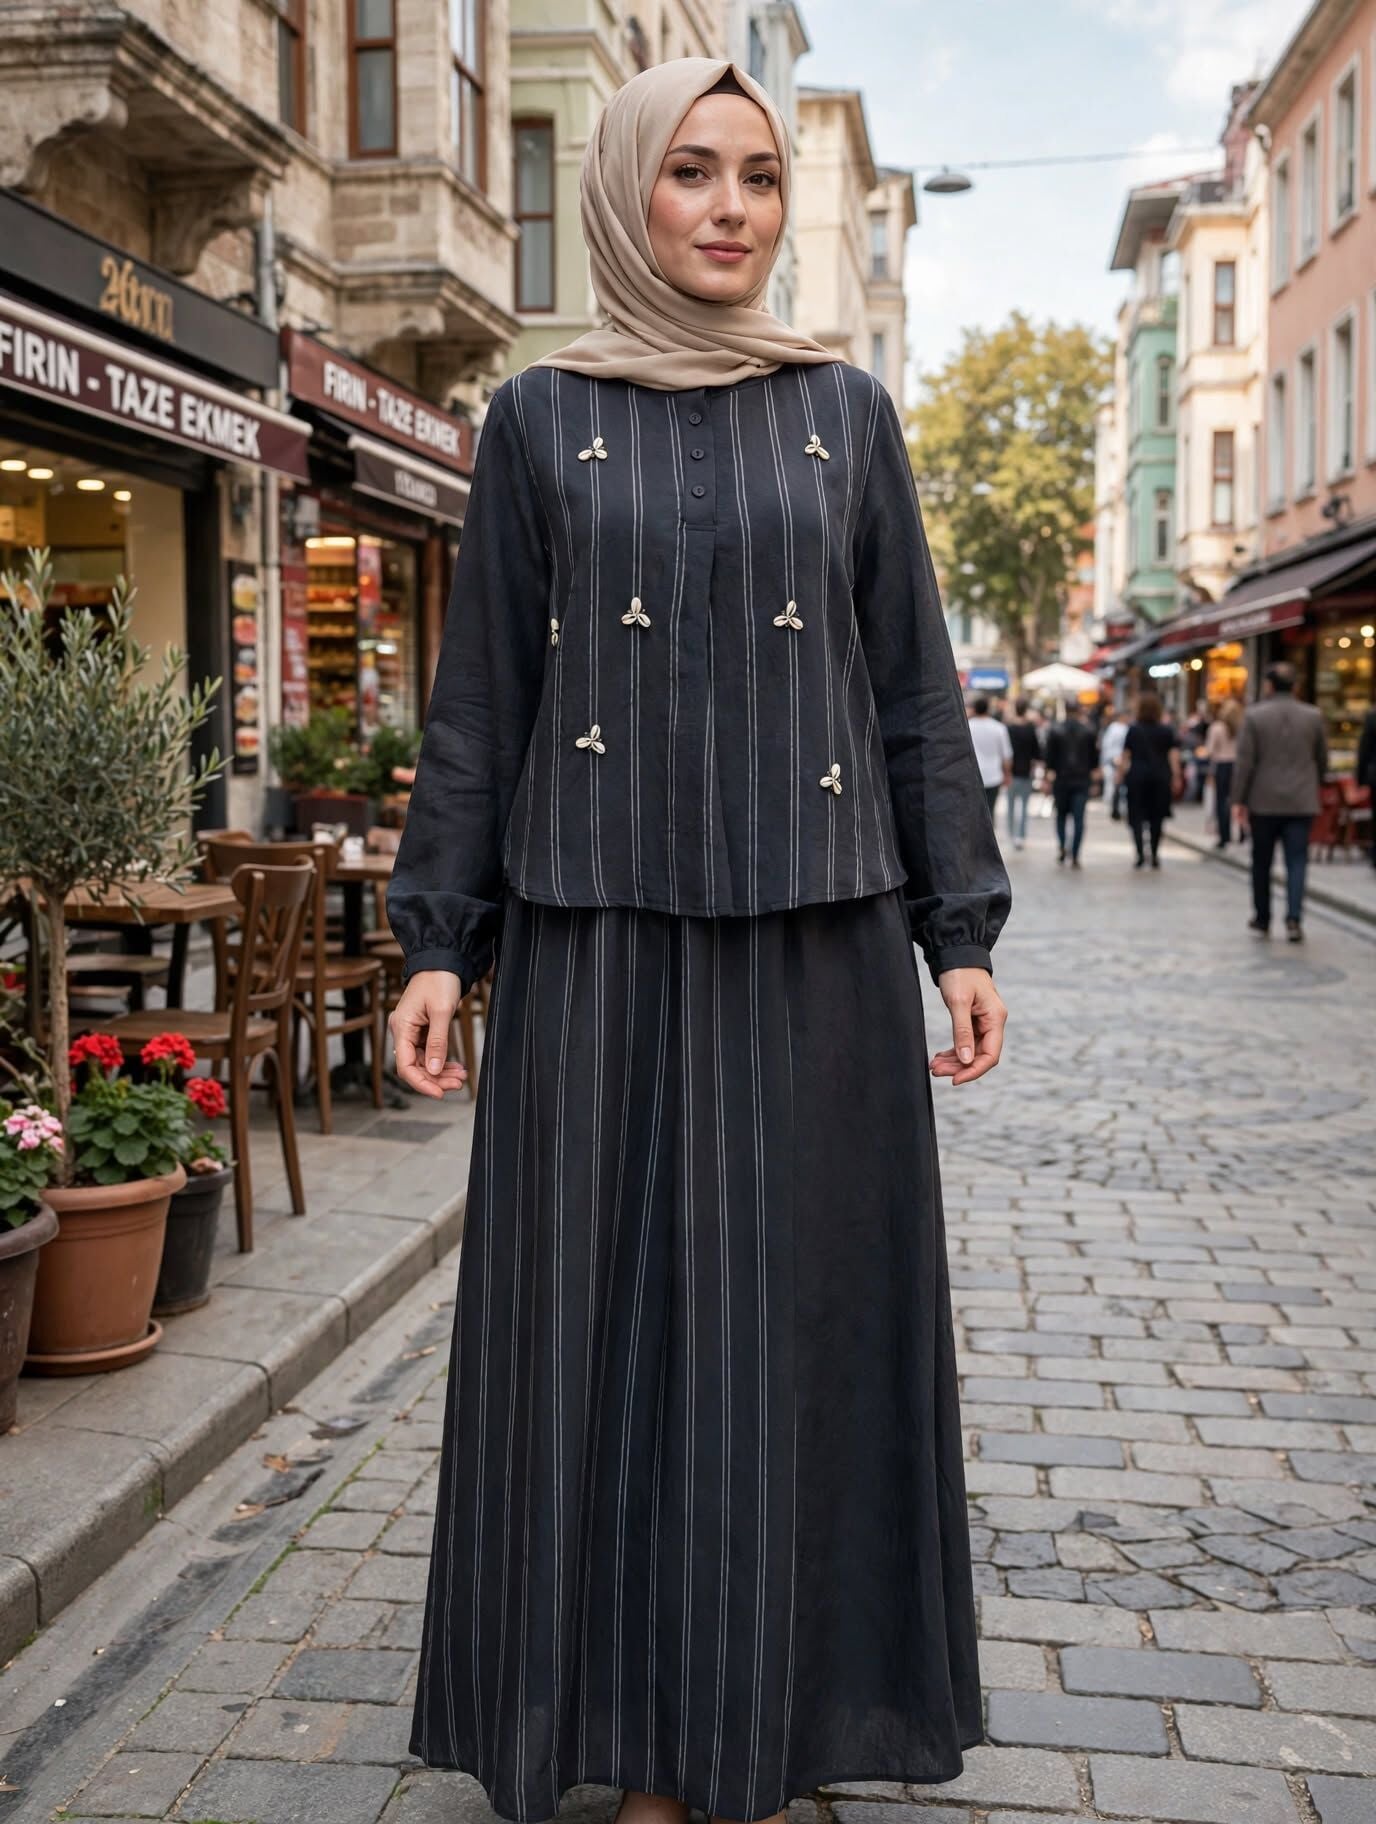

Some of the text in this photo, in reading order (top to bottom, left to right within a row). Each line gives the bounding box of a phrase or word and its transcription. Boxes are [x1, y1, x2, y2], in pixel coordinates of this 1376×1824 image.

[0, 321, 79, 397] FIRIN
[104, 364, 175, 430] TAZE
[180, 392, 261, 460] EKMEK
